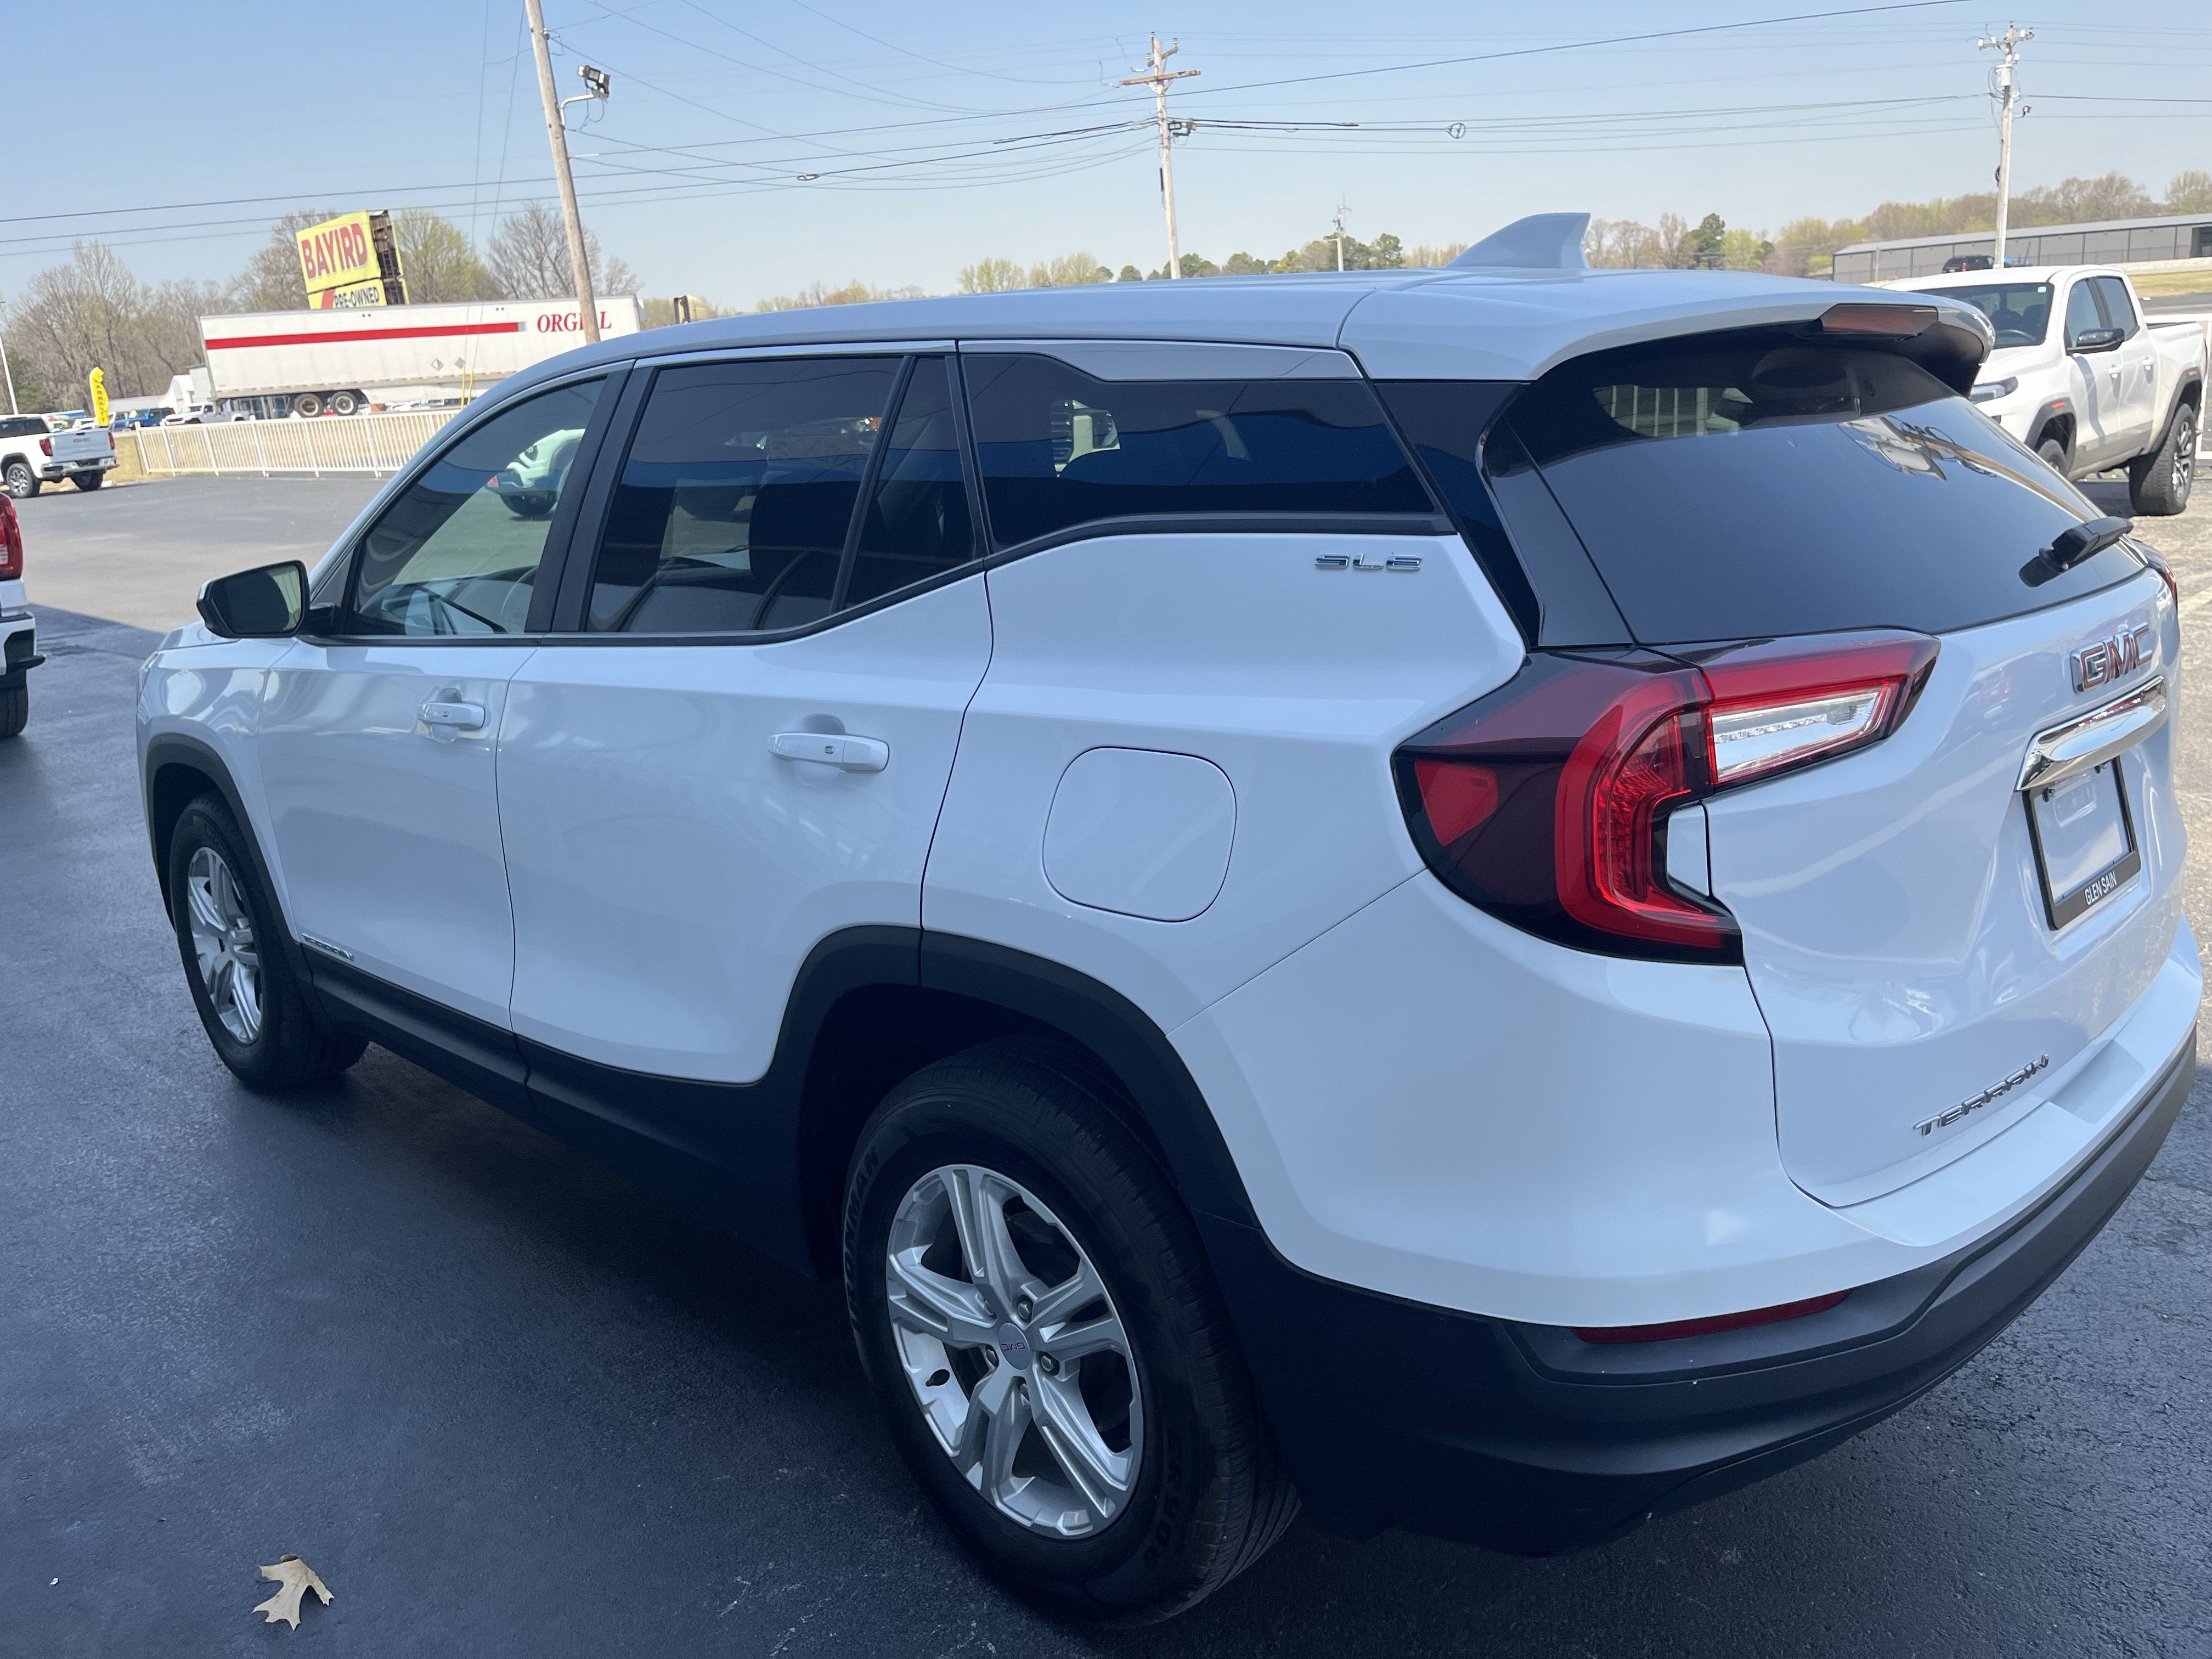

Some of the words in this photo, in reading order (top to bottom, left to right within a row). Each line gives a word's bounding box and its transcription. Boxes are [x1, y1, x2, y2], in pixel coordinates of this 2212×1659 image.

[301, 223, 368, 279] BAYIRD
[334, 286, 380, 309] PRE-OWNED
[537, 311, 612, 333] ORGIL
[2073, 622, 2153, 692] GMC
[2084, 880, 2102, 905] GLEN
[2101, 870, 2118, 893] SAIN
[1912, 1053, 2050, 1137] TERRAIN
[1000, 1341, 1026, 1352] GMC
